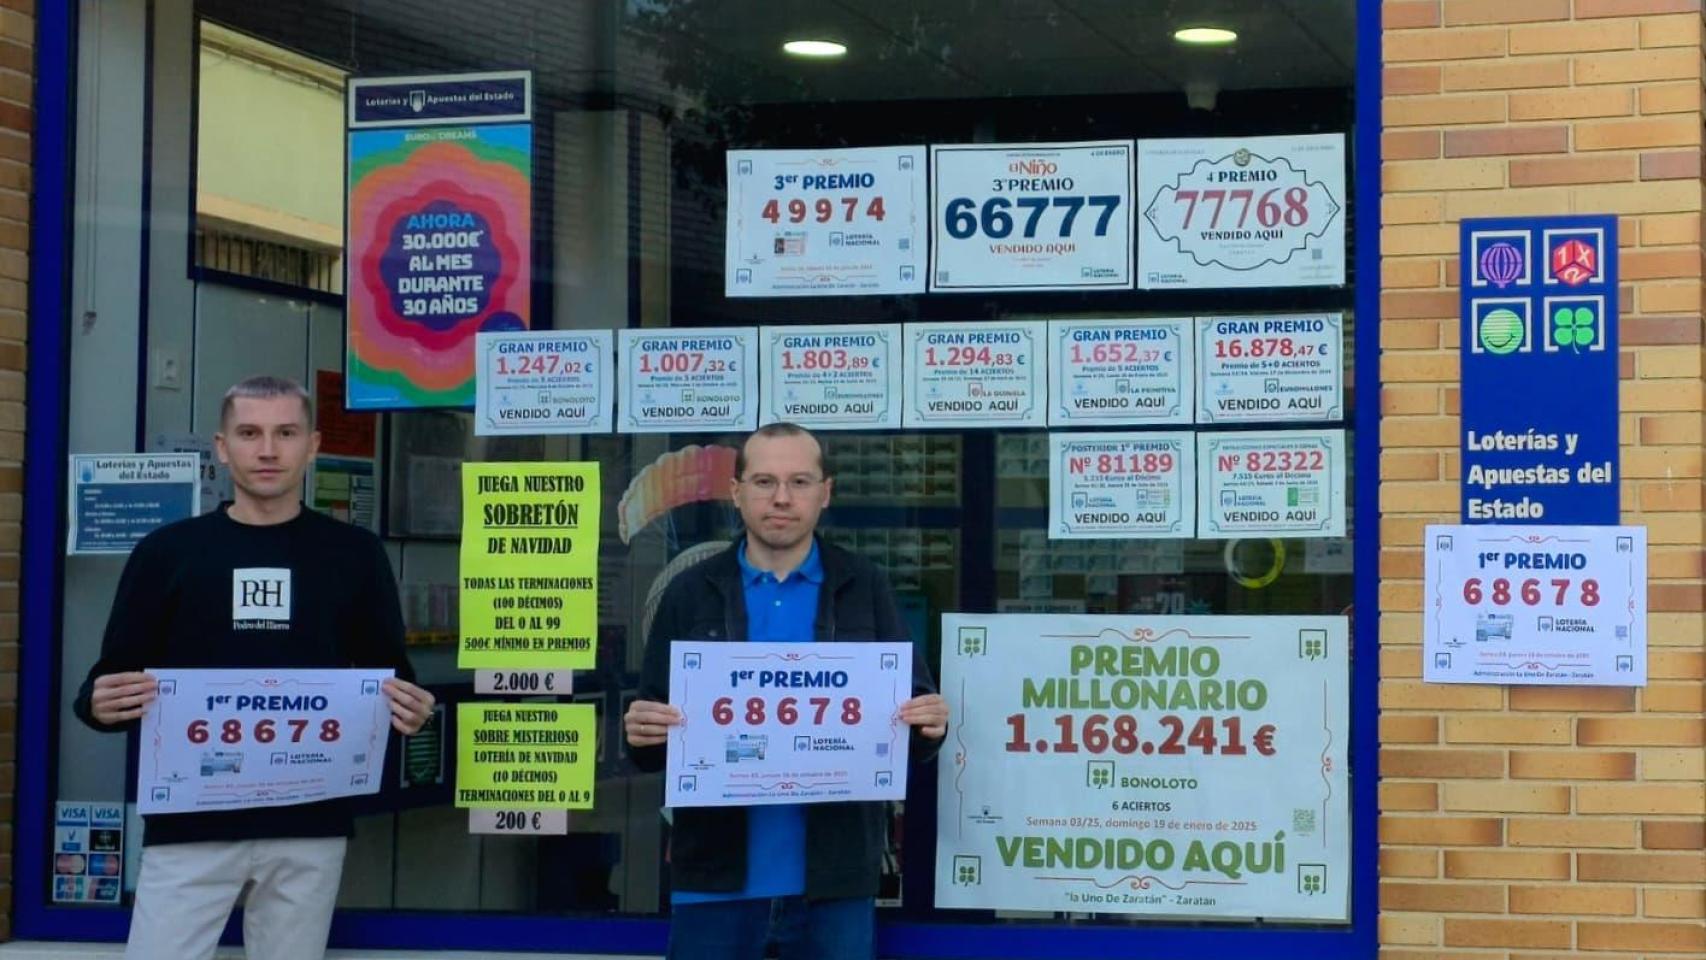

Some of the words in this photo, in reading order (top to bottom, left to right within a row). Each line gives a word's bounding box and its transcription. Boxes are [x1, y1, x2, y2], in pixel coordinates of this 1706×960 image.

[1019, 158, 1058, 177] Niño
[1218, 169, 1278, 183] PREMIO
[774, 175, 799, 190] 3er
[802, 172, 875, 190] PREMIO
[1008, 177, 1075, 192] PREMIO
[761, 196, 886, 224] 49974
[1174, 186, 1310, 231] 77768
[406, 212, 476, 230] AHORA
[944, 195, 1121, 240] 66777
[1200, 230, 1252, 242] VENDIDO
[989, 243, 1043, 255] VENDIDO
[409, 255, 433, 272] AL
[436, 253, 473, 270] MES
[398, 275, 484, 294] DURANTE
[402, 298, 427, 316] 30
[428, 293, 478, 314] AÑOS
[1072, 329, 1111, 341] GRAN
[1114, 328, 1167, 341] PREMIO
[1216, 321, 1259, 334] GRAN
[1263, 319, 1324, 333] PREMIO
[642, 340, 679, 352] GRAN
[682, 339, 733, 352] PREMIO
[783, 336, 821, 348] GRAN
[824, 335, 876, 347] PREMIO
[927, 333, 965, 344] GRAN
[968, 332, 1020, 344] PREMIO
[499, 341, 535, 354] GRAN
[538, 340, 588, 353] PREMIO
[1069, 342, 1160, 364] 1.652,37
[1163, 350, 1172, 361] €
[1214, 337, 1314, 358] 16.878,47
[1317, 343, 1328, 356] €
[497, 354, 582, 375] 1.247,02
[584, 362, 593, 373] €
[639, 352, 725, 375] 1.007,32
[728, 360, 737, 372] €
[781, 350, 868, 370] 1.803,89
[871, 357, 880, 368] €
[925, 346, 1013, 367] 1.294,83
[1016, 354, 1025, 365] €
[784, 403, 838, 414] VENDIDO
[844, 400, 874, 414] AQUÍ
[928, 400, 982, 412] VENDIDO
[988, 397, 1018, 411] AQUÍ
[1073, 397, 1129, 409] VENDIDO
[1135, 395, 1165, 409] AQUÍ
[1217, 397, 1281, 411] VENDIDO
[1287, 394, 1322, 410] AQUÍ
[499, 408, 551, 420] VENDIDO
[556, 405, 586, 419] AQUÍ
[642, 406, 695, 418] VENDIDO
[700, 404, 731, 417] AQUÍ
[1466, 428, 1558, 451] Loterías
[1564, 432, 1578, 455] y
[1069, 456, 1091, 475] Nº
[1096, 452, 1174, 474] 81189
[1218, 454, 1240, 472] Nº
[1246, 450, 1324, 472] 82322
[1466, 464, 1570, 490] Apuestas
[1576, 461, 1612, 484] del
[477, 475, 519, 494] JUEGA
[523, 475, 584, 492] NUESTRO
[483, 499, 579, 527] SOBRETÓN
[1223, 510, 1279, 523] VENDIDO
[1285, 507, 1317, 522] AQUÍ
[1467, 496, 1543, 519] Estado
[1074, 512, 1130, 524] VENDIDO
[1135, 509, 1167, 524] AQUÍ
[486, 537, 506, 554] DE
[510, 537, 572, 554] NAVIDAD
[1477, 551, 1500, 569] 1er
[1503, 552, 1587, 570] PREMIO
[463, 577, 496, 590] TODAS
[498, 577, 514, 590] LAS
[517, 577, 593, 590] TERMINACIONES
[1462, 577, 1600, 607] 68678
[493, 597, 514, 610] (100
[517, 596, 563, 610] DÉCIMOS)
[494, 616, 514, 630] DEL
[518, 616, 526, 630] 0
[529, 616, 542, 630] AL
[545, 616, 561, 630] 99
[1555, 625, 1594, 633] NACIONAL
[464, 636, 490, 650] 500€
[493, 635, 529, 650] MÍNIMO
[533, 637, 544, 650] EN
[547, 637, 591, 650] PREMIOS
[1070, 644, 1221, 679] PREMIO
[493, 672, 539, 691] 2.000
[544, 672, 555, 691] €
[729, 669, 755, 688] 1er
[759, 669, 849, 689] PREMIO
[206, 694, 232, 711] 1er
[236, 694, 329, 712] PREMIO
[1022, 677, 1268, 712] MILLONARIO
[483, 709, 512, 724] JUEGA
[515, 709, 558, 723] NUESTRO
[711, 696, 862, 726] 68678
[186, 717, 341, 745] 68678
[473, 729, 510, 744] SOBRE
[513, 729, 579, 745] MISTERIOSO
[474, 749, 516, 763] LOTERÍA
[518, 751, 531, 763] DE
[534, 750, 578, 764] NAVIDAD
[813, 744, 855, 752] NACIONAL
[493, 770, 508, 784] (10
[511, 769, 558, 784] DÉCIMOS)
[1120, 776, 1198, 790] BONOLOTO
[459, 788, 535, 803] TERMINACIONES
[537, 789, 556, 803] DEL
[559, 790, 566, 803] 0
[568, 790, 580, 803] AL
[583, 790, 591, 803] 9
[62, 807, 87, 818] VISA
[95, 807, 120, 819] VISA
[1111, 800, 1119, 812] 6
[1120, 800, 1172, 813] ACIERTOS
[495, 811, 527, 830] 200
[531, 811, 542, 830] €
[1025, 816, 1069, 828] Semana
[1070, 816, 1102, 830] 03/25,
[1105, 817, 1151, 832] domingo
[1153, 818, 1166, 830] 19
[1167, 818, 1181, 831] de
[1182, 821, 1212, 832] enero
[1213, 819, 1230, 832] de
[1231, 820, 1257, 833] 2025
[995, 835, 1176, 871] VENDIDO
[1181, 829, 1286, 881] AQUÍ
[1081, 892, 1104, 904] Uno
[1105, 892, 1120, 904] De
